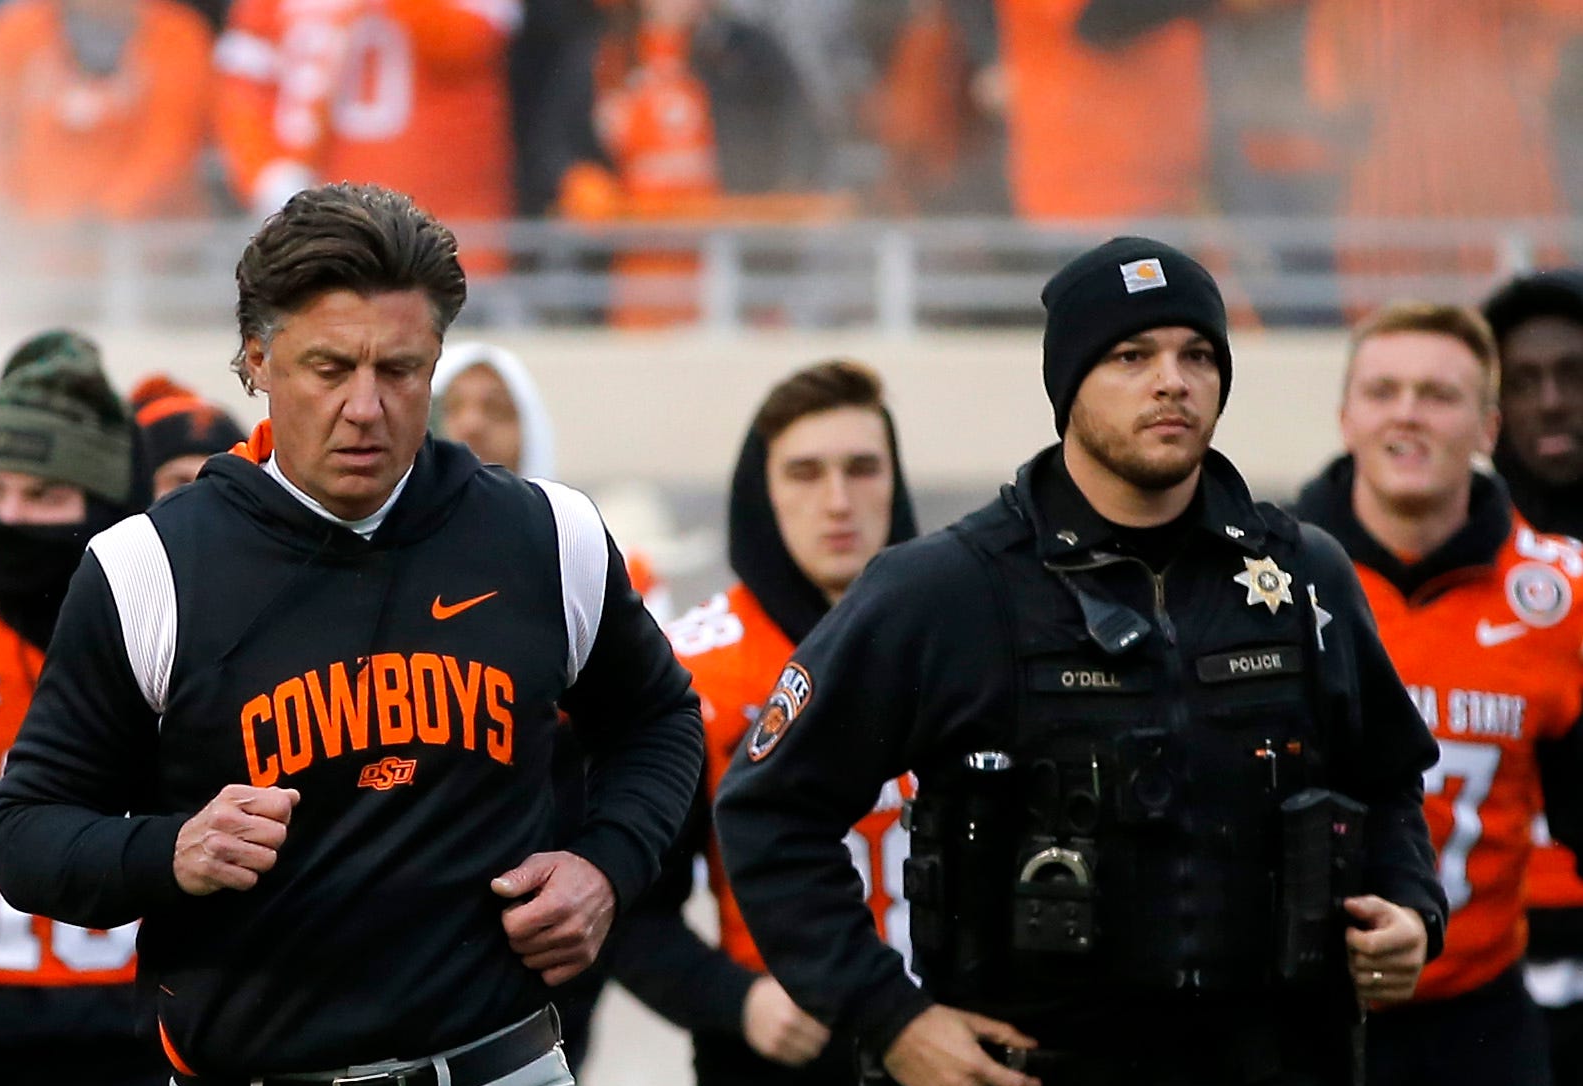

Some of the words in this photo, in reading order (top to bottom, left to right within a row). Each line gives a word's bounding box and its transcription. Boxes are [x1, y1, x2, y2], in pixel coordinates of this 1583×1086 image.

[1061, 671, 1120, 688] O'DELL
[1229, 653, 1283, 674] POLICE
[240, 652, 515, 788] COWBOYS
[1448, 688, 1526, 739] STATE
[359, 757, 416, 790] OSU
